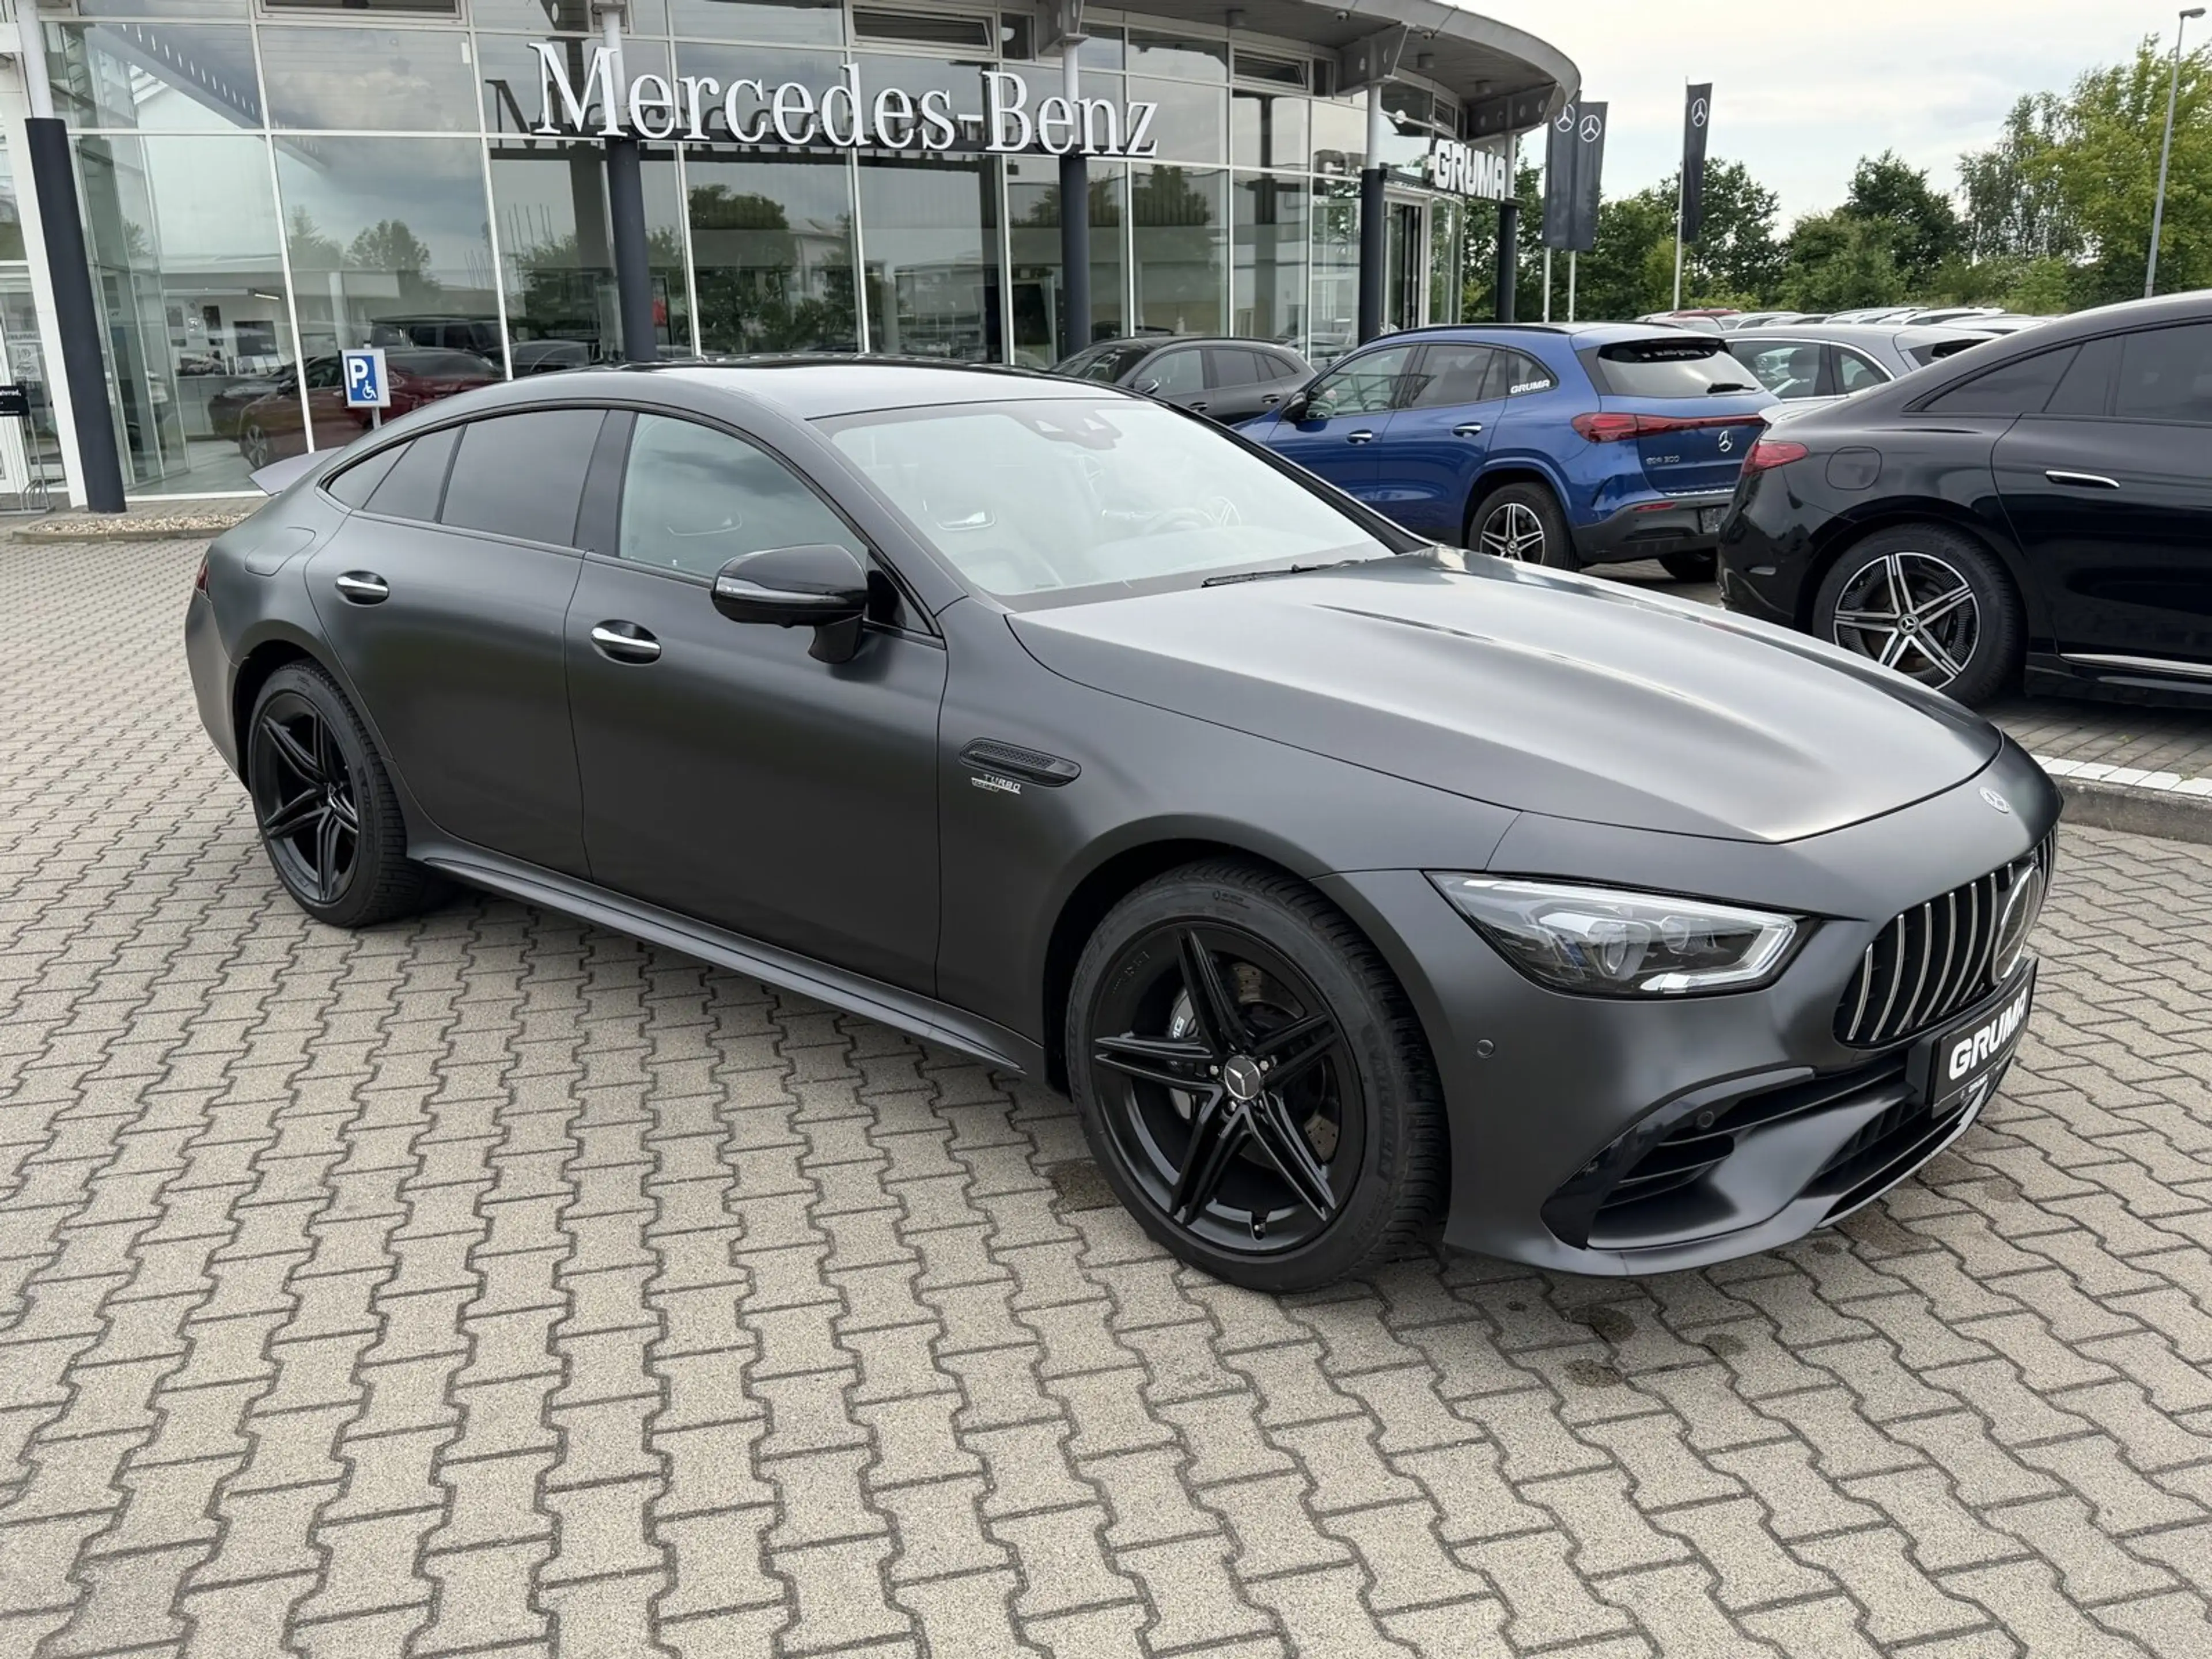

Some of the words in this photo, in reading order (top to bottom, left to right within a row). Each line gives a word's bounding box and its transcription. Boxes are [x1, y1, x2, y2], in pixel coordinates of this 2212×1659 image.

[527, 42, 1158, 156] Mercedes-Benz
[1433, 138, 1507, 200] GRUMA
[349, 358, 369, 389] P
[1510, 379, 1550, 393] GRUMA
[983, 774, 1021, 791] TURBO
[1949, 986, 2028, 1080] GRUMA
